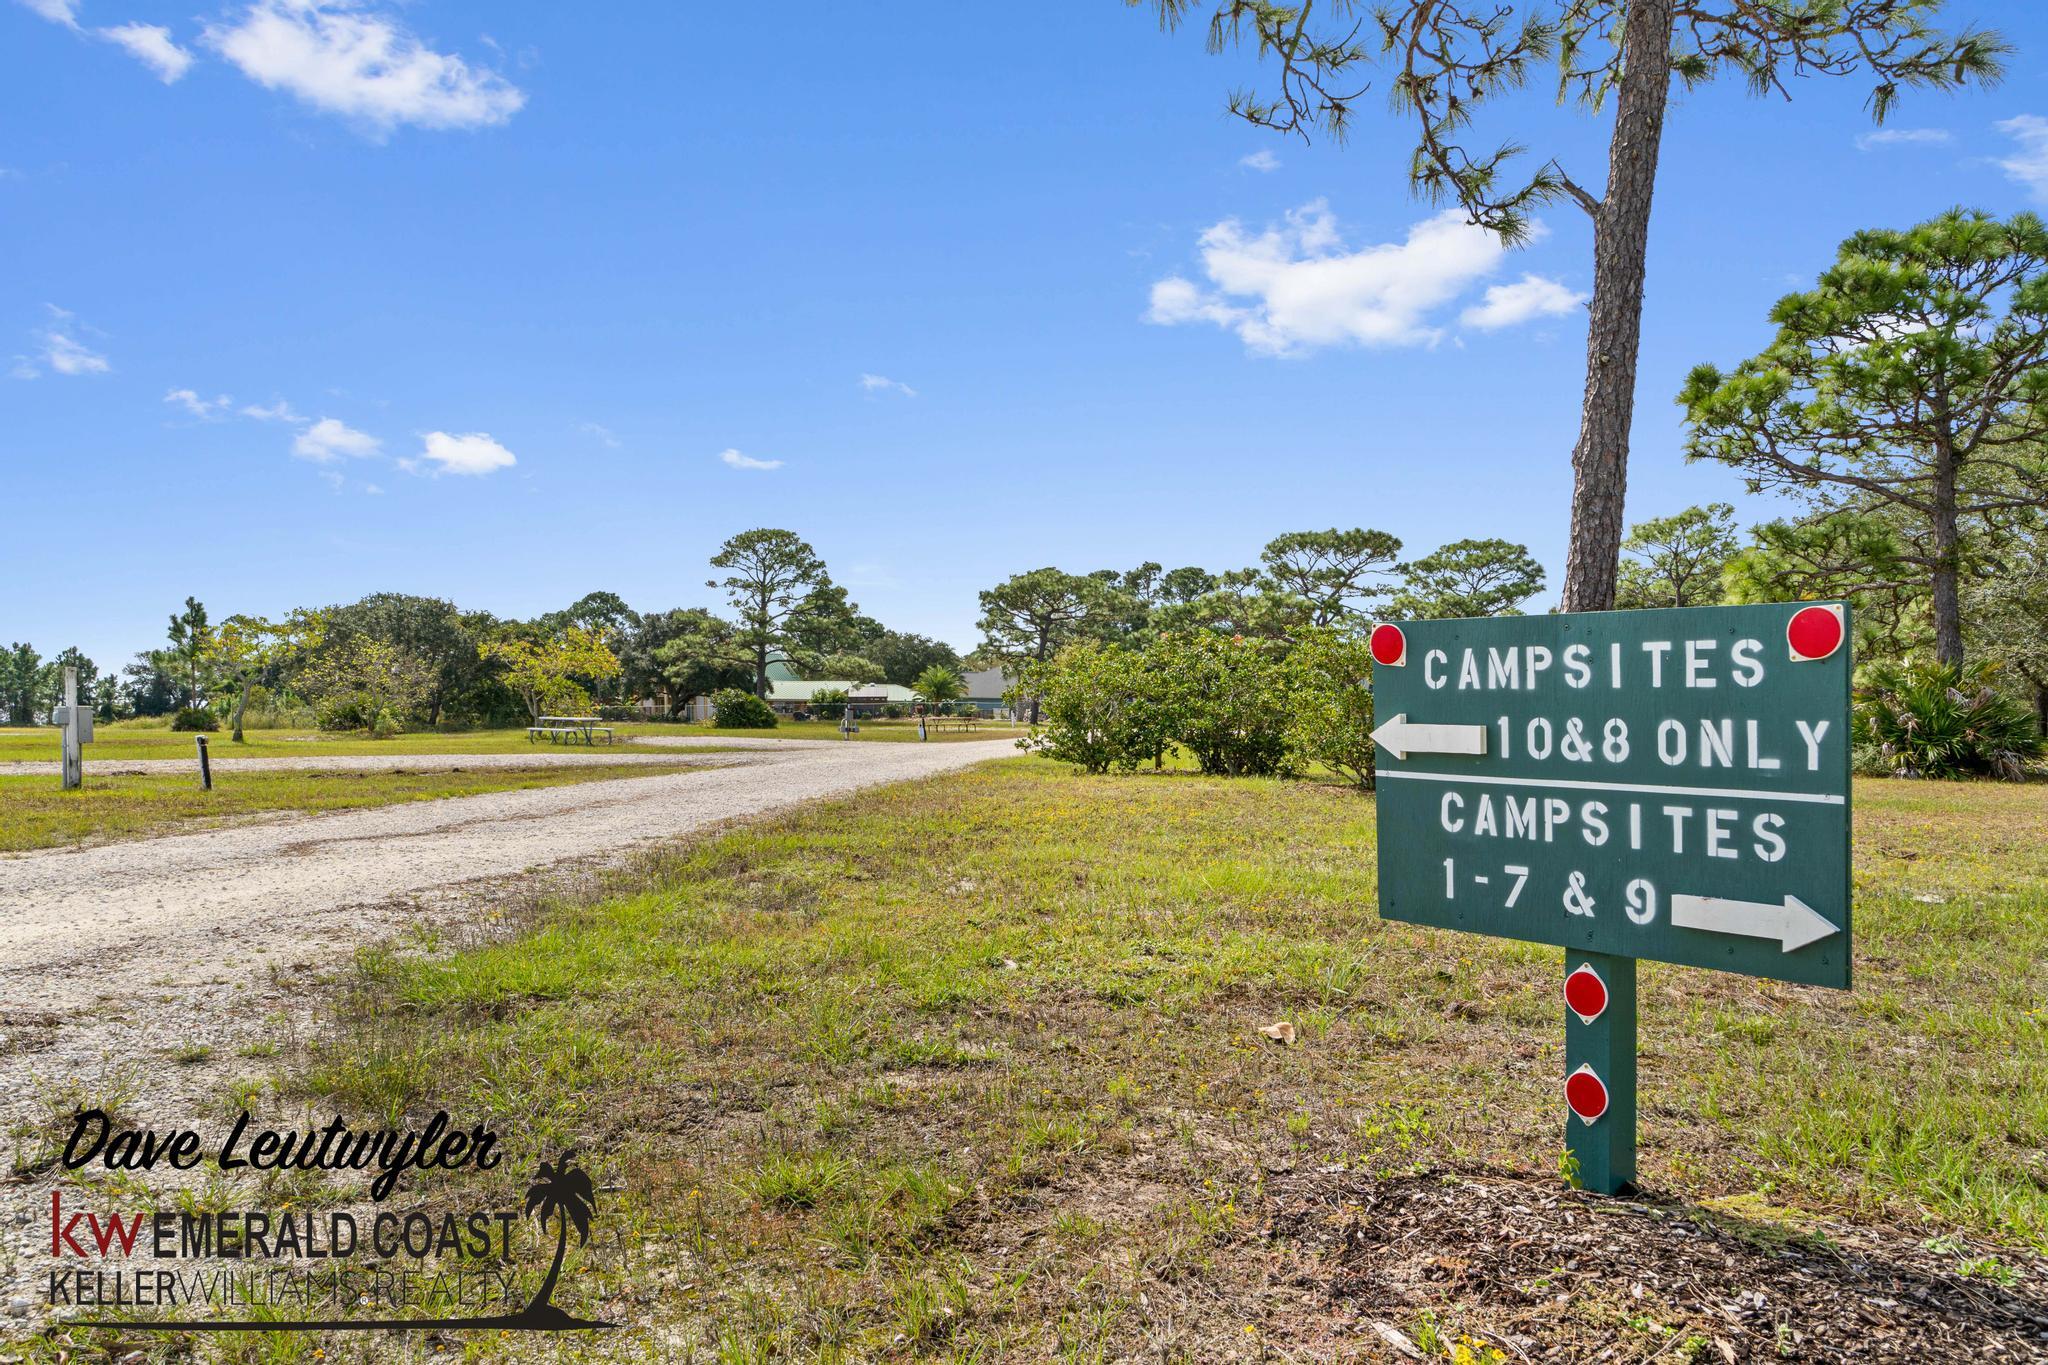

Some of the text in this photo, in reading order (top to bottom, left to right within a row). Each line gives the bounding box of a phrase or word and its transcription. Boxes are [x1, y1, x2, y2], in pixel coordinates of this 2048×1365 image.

[1424, 639, 1764, 690] CAMPSITES
[1498, 716, 1830, 771] 10&8 ONLY
[1441, 791, 1786, 862] CAMPSITES
[1563, 870, 1596, 917] &
[1625, 878, 1656, 925] 9
